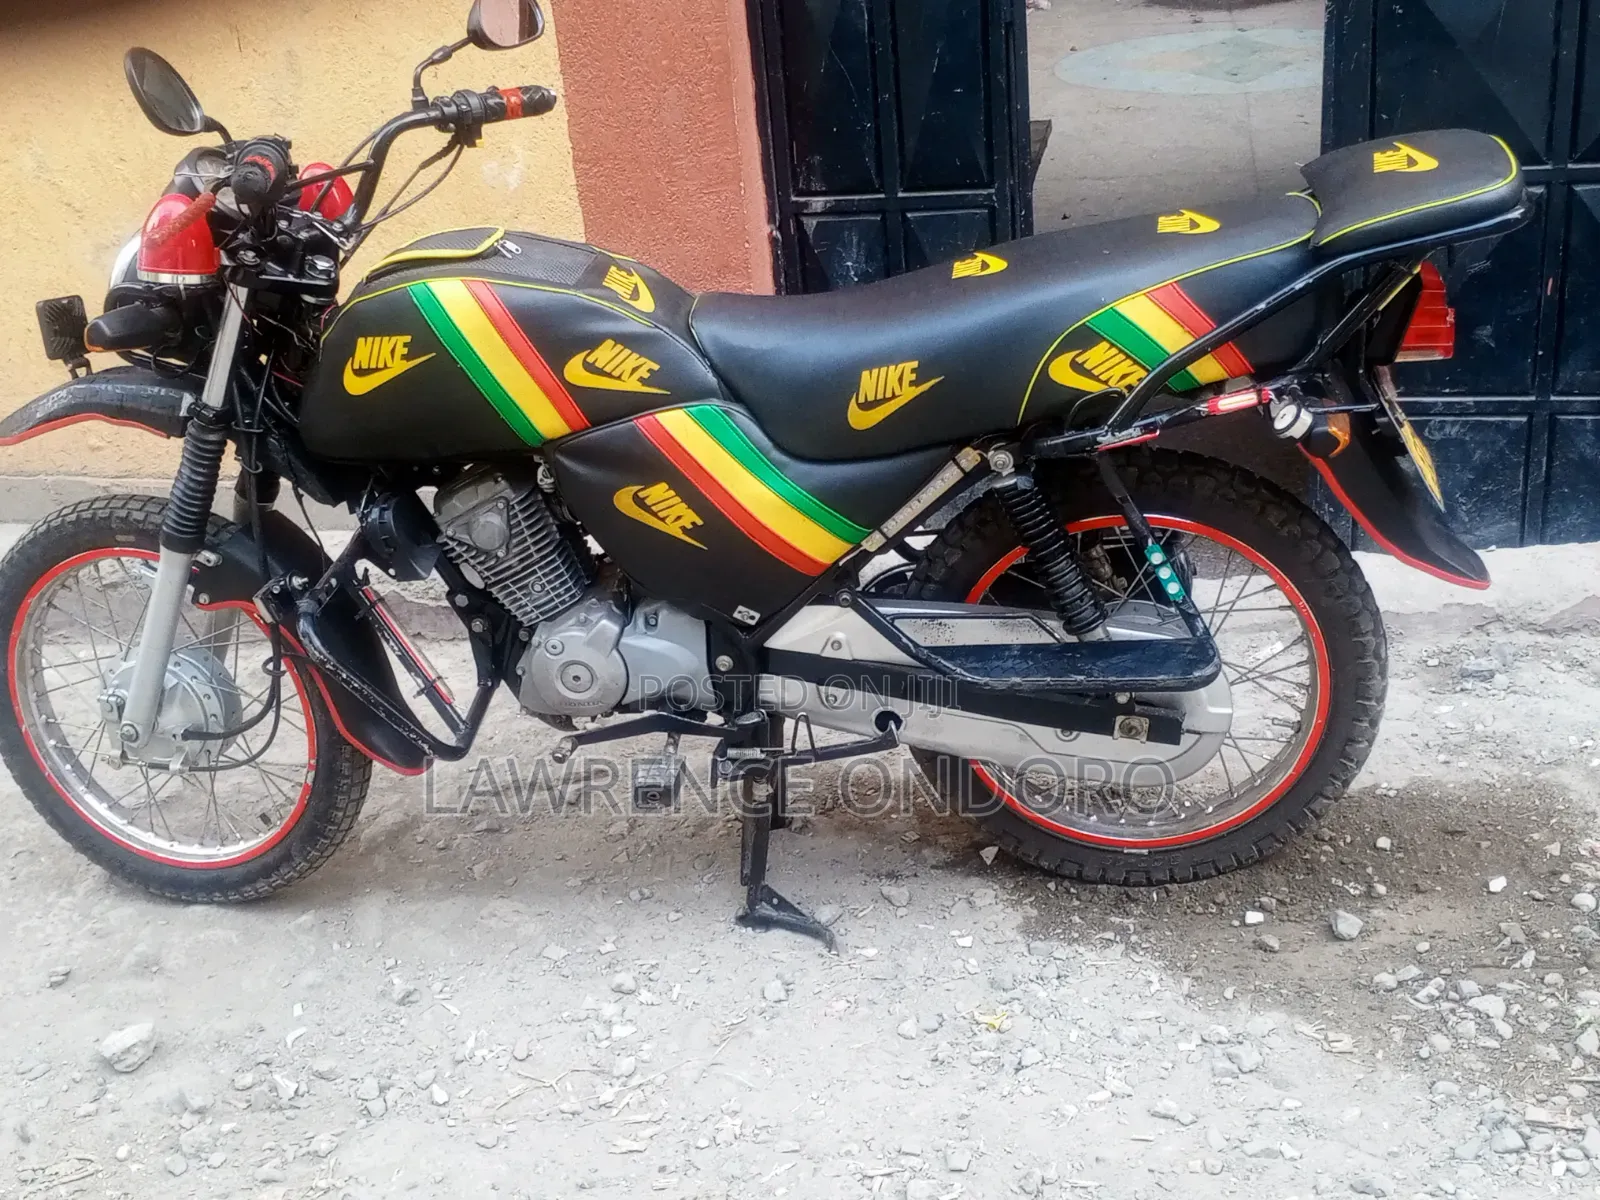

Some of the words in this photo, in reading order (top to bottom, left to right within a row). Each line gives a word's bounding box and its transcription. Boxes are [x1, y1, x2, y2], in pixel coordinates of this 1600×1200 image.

[353, 335, 412, 369] NIKE
[585, 338, 661, 386] NIKE
[1074, 340, 1148, 396] NIKE
[858, 360, 919, 404] NIKE
[636, 481, 704, 536] NIKE
